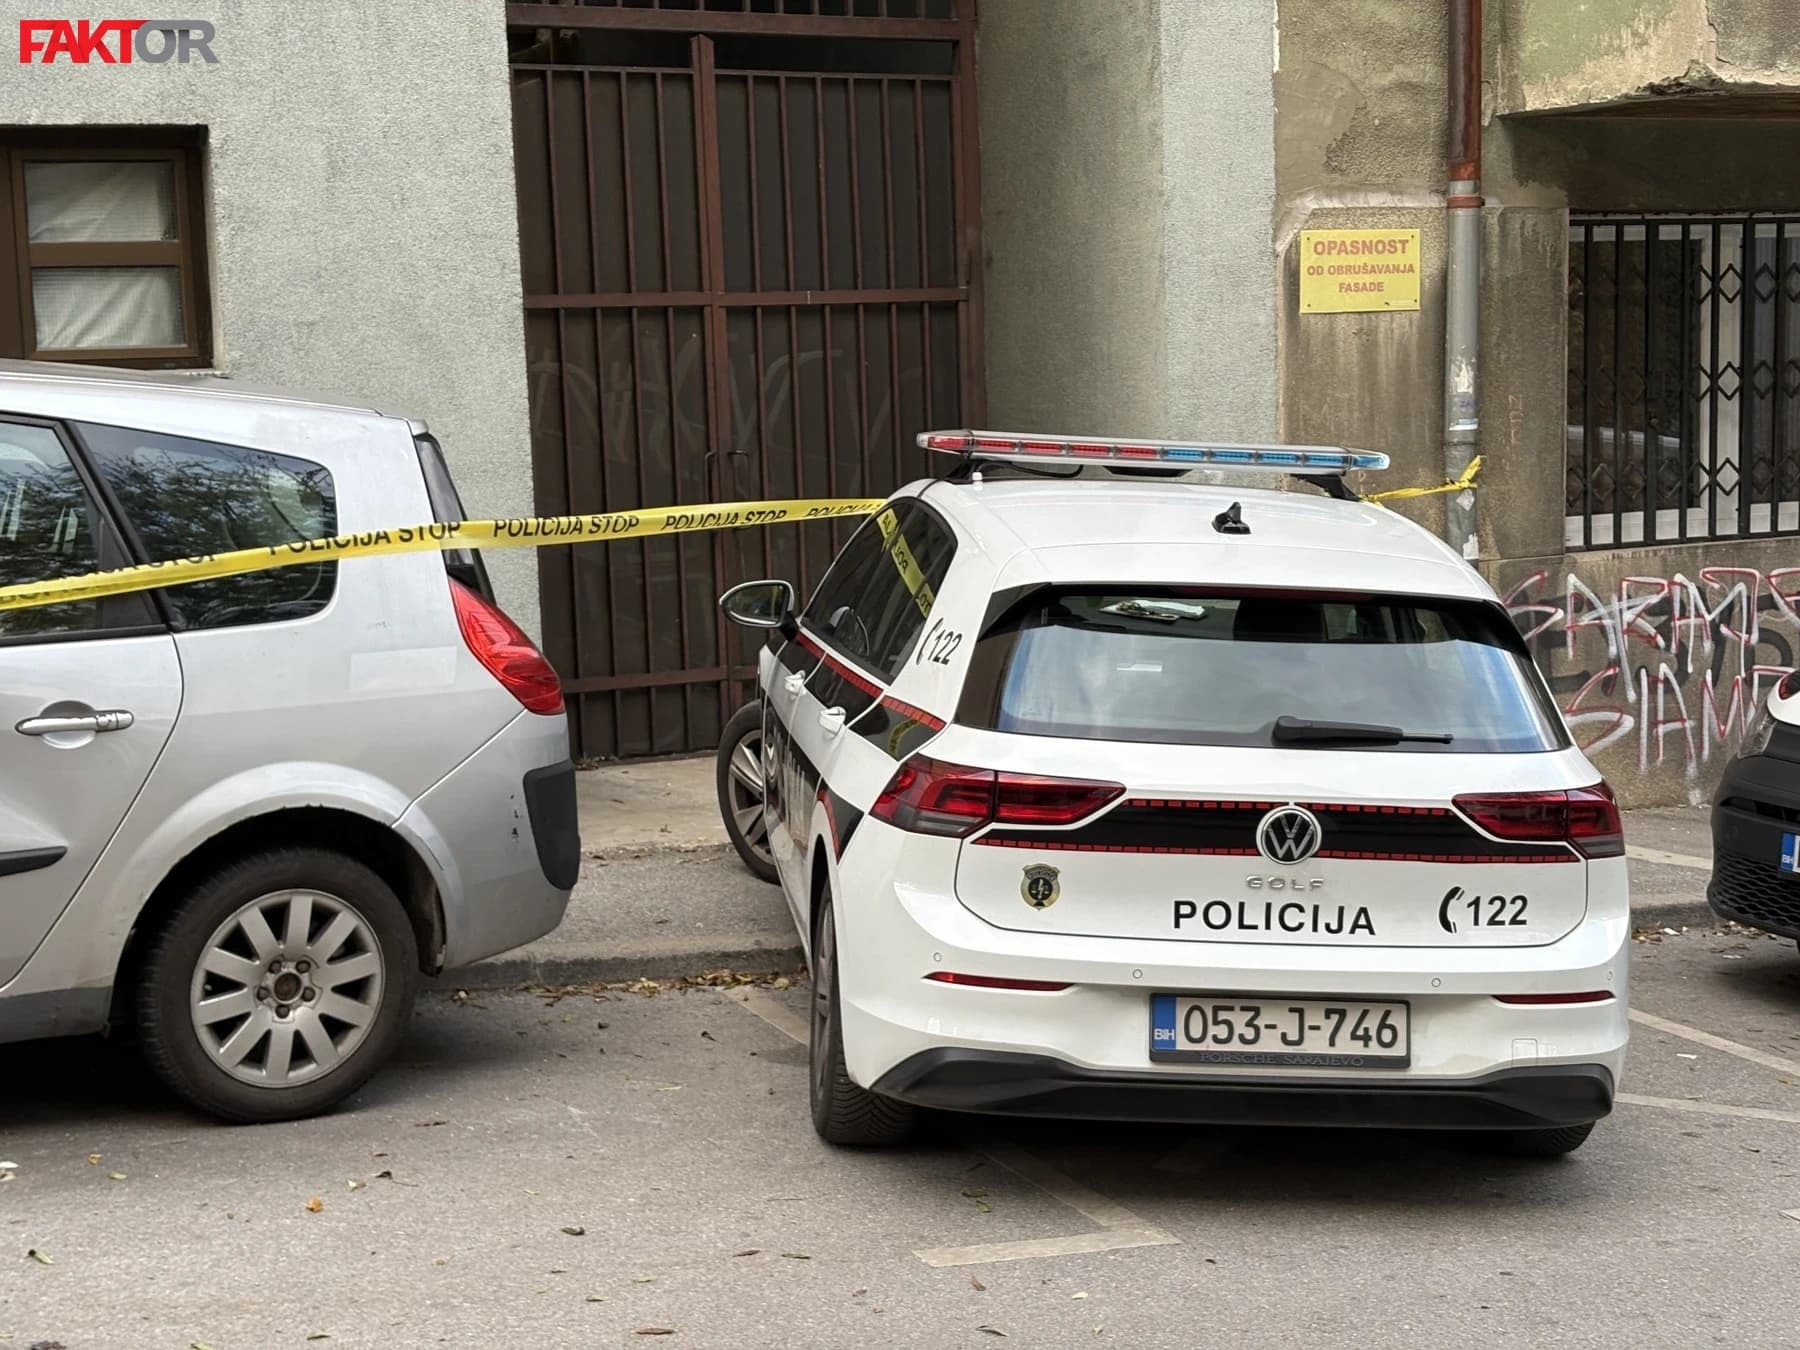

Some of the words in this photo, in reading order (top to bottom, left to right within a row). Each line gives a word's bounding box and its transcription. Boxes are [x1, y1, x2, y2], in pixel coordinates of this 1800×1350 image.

[1313, 239, 1409, 255] OPASNOST
[1307, 265, 1325, 276] OD
[1327, 262, 1415, 276] OBRUŠAVANJA
[1338, 281, 1385, 293] FASADE
[493, 514, 583, 538] POLICIJA
[588, 514, 640, 535] STOP
[927, 628, 963, 666] 122
[1246, 875, 1325, 890] GOLF
[1174, 899, 1376, 935] POLICIJA
[1466, 895, 1528, 926] 122
[1154, 1028, 1175, 1040] BIH
[1184, 1004, 1398, 1048] 053-J-746
